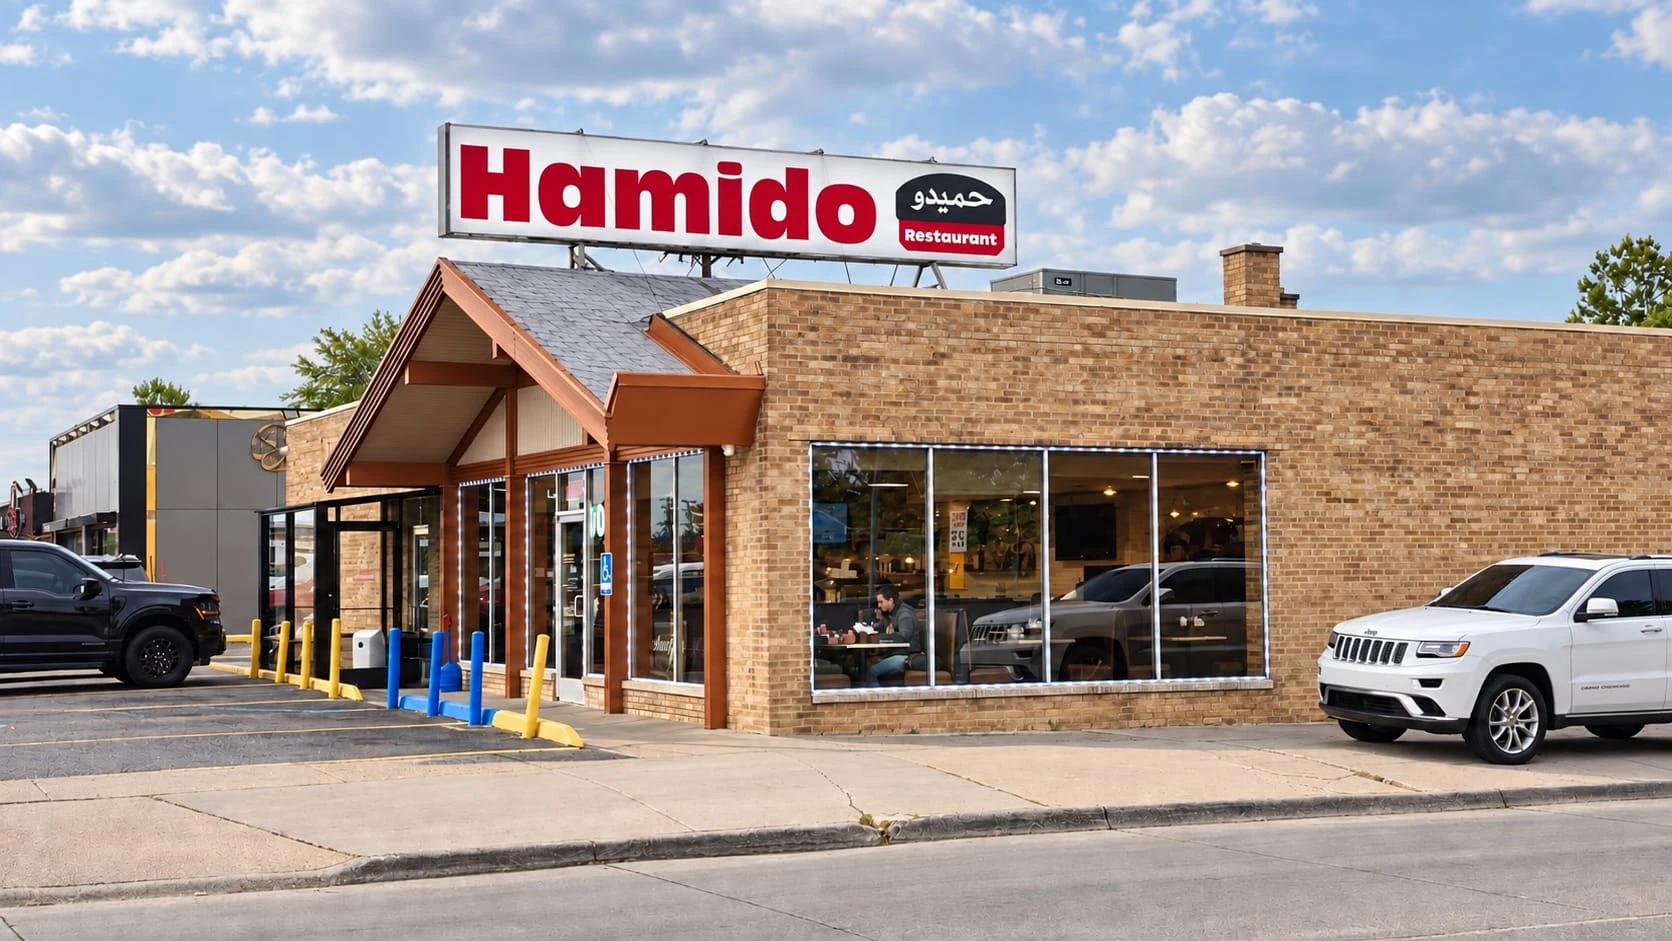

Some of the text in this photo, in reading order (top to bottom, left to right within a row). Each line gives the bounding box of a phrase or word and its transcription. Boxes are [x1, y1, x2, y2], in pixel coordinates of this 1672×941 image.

[460, 144, 877, 245] Hamido
[910, 188, 993, 214] حميدو
[904, 229, 997, 246] Restaurant
